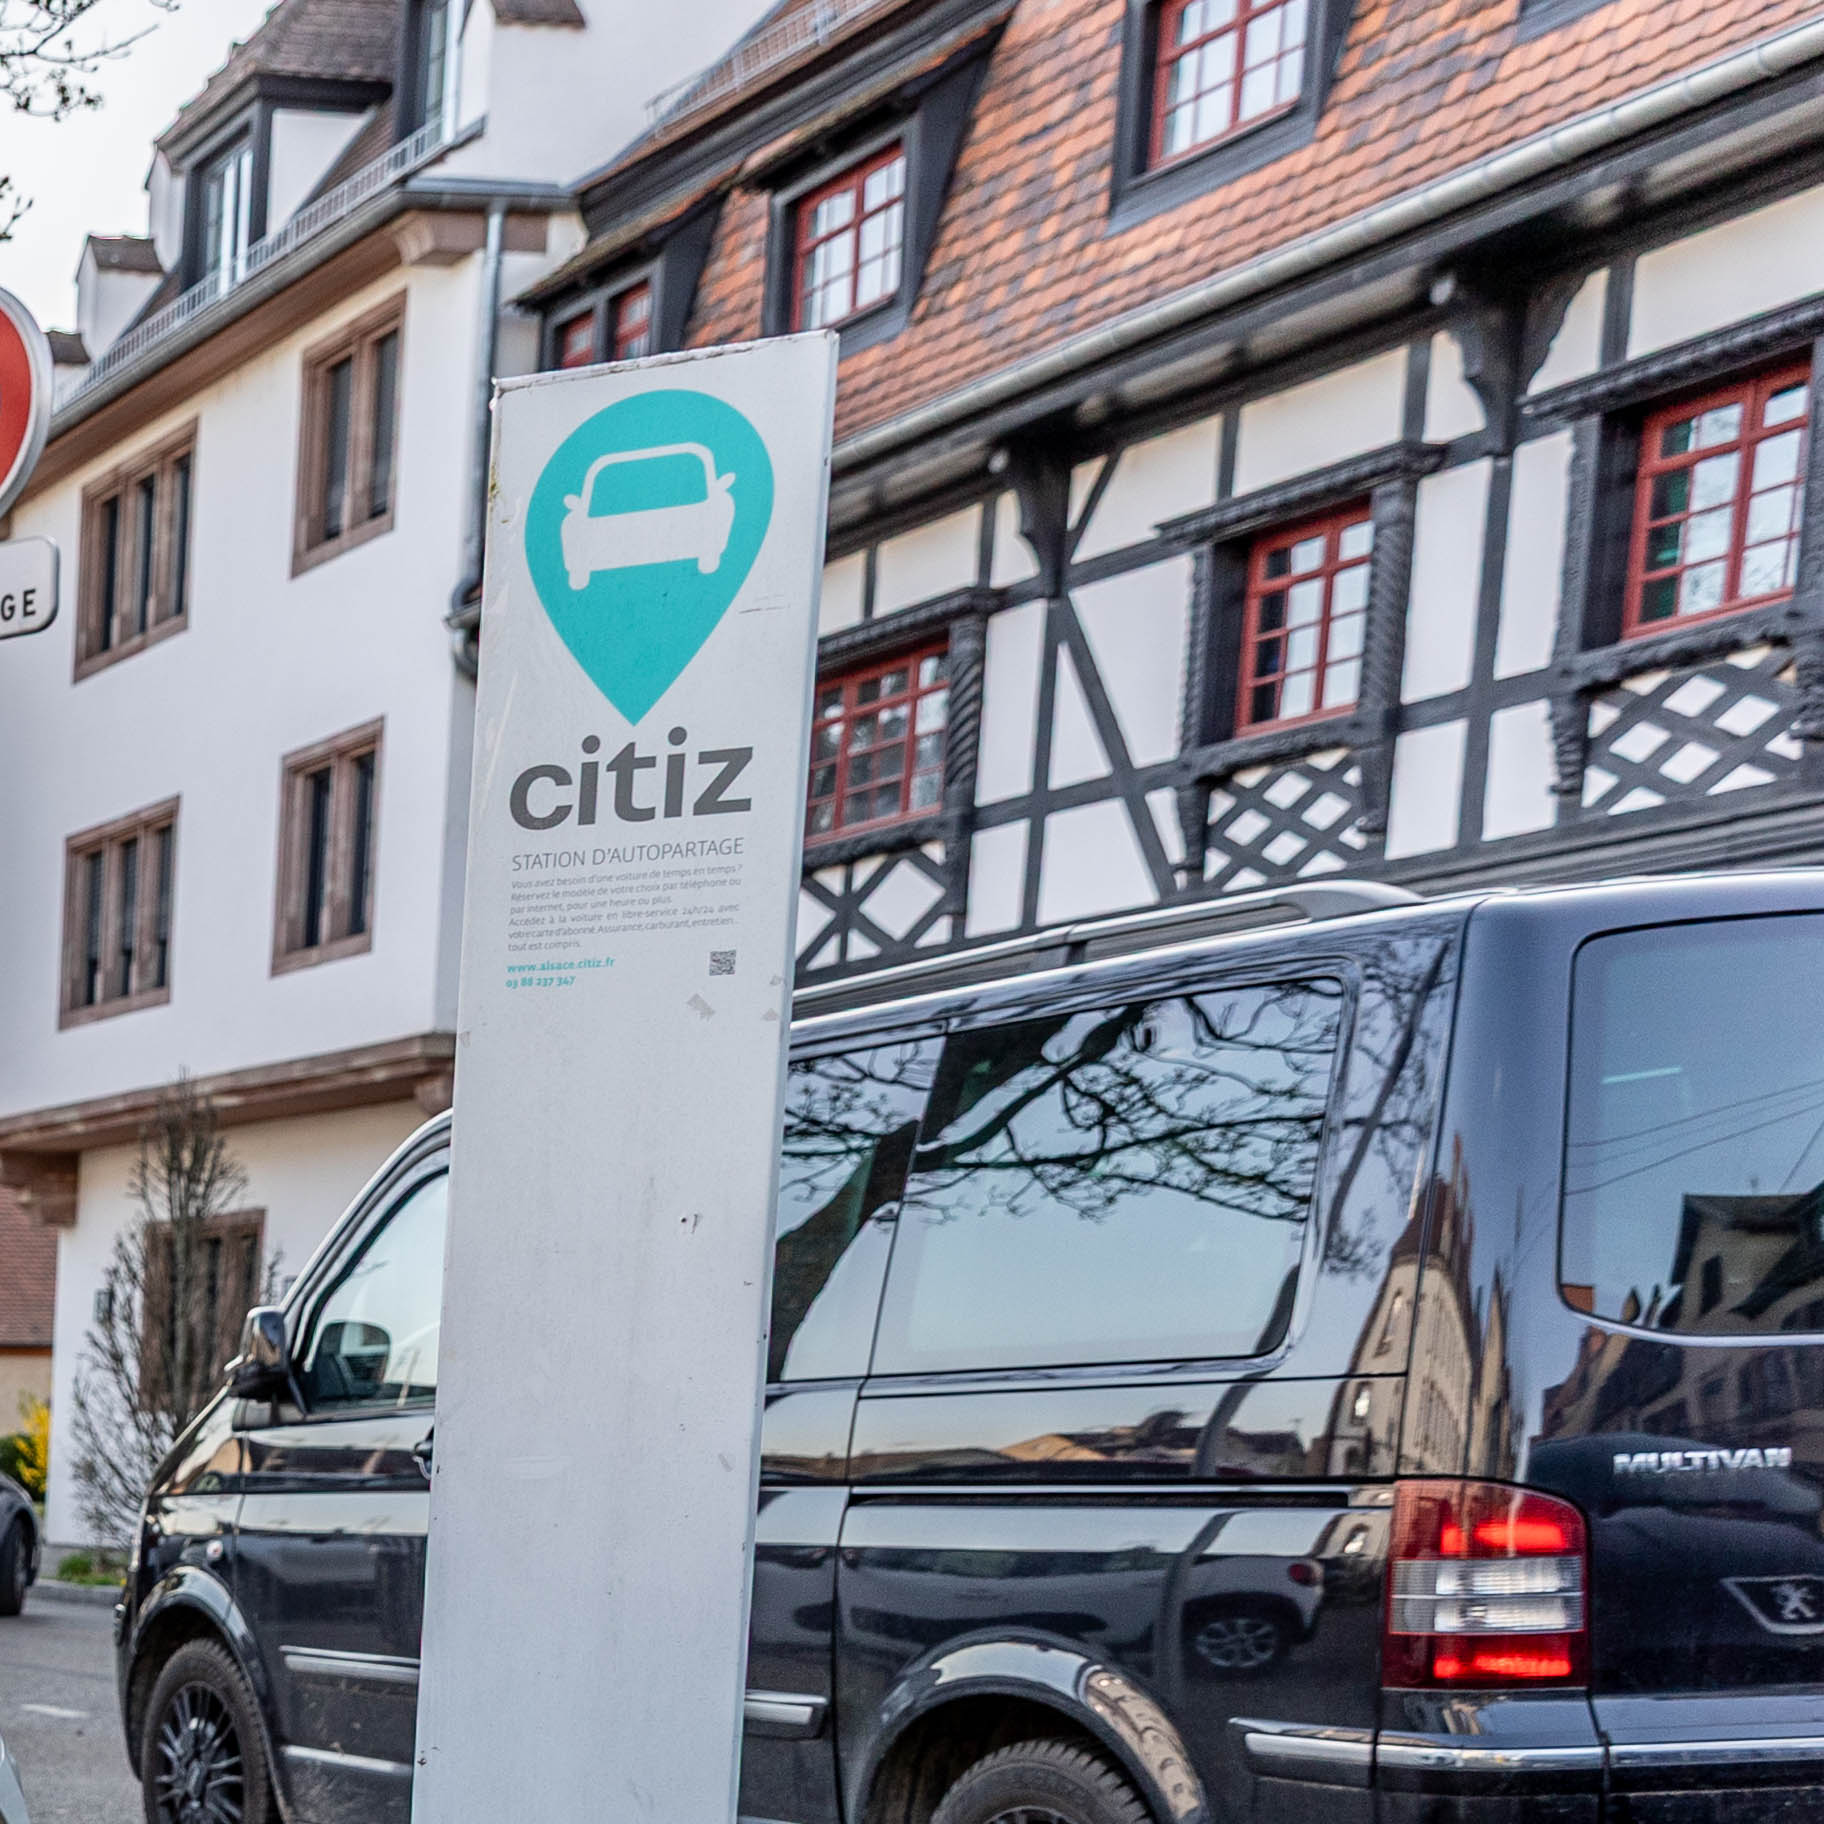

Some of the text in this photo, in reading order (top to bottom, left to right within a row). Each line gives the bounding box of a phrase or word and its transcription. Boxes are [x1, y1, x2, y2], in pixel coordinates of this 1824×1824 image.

[509, 726, 754, 831] citiz
[511, 851, 586, 871] STATION
[1613, 1447, 1792, 1475] MULTIVAN
